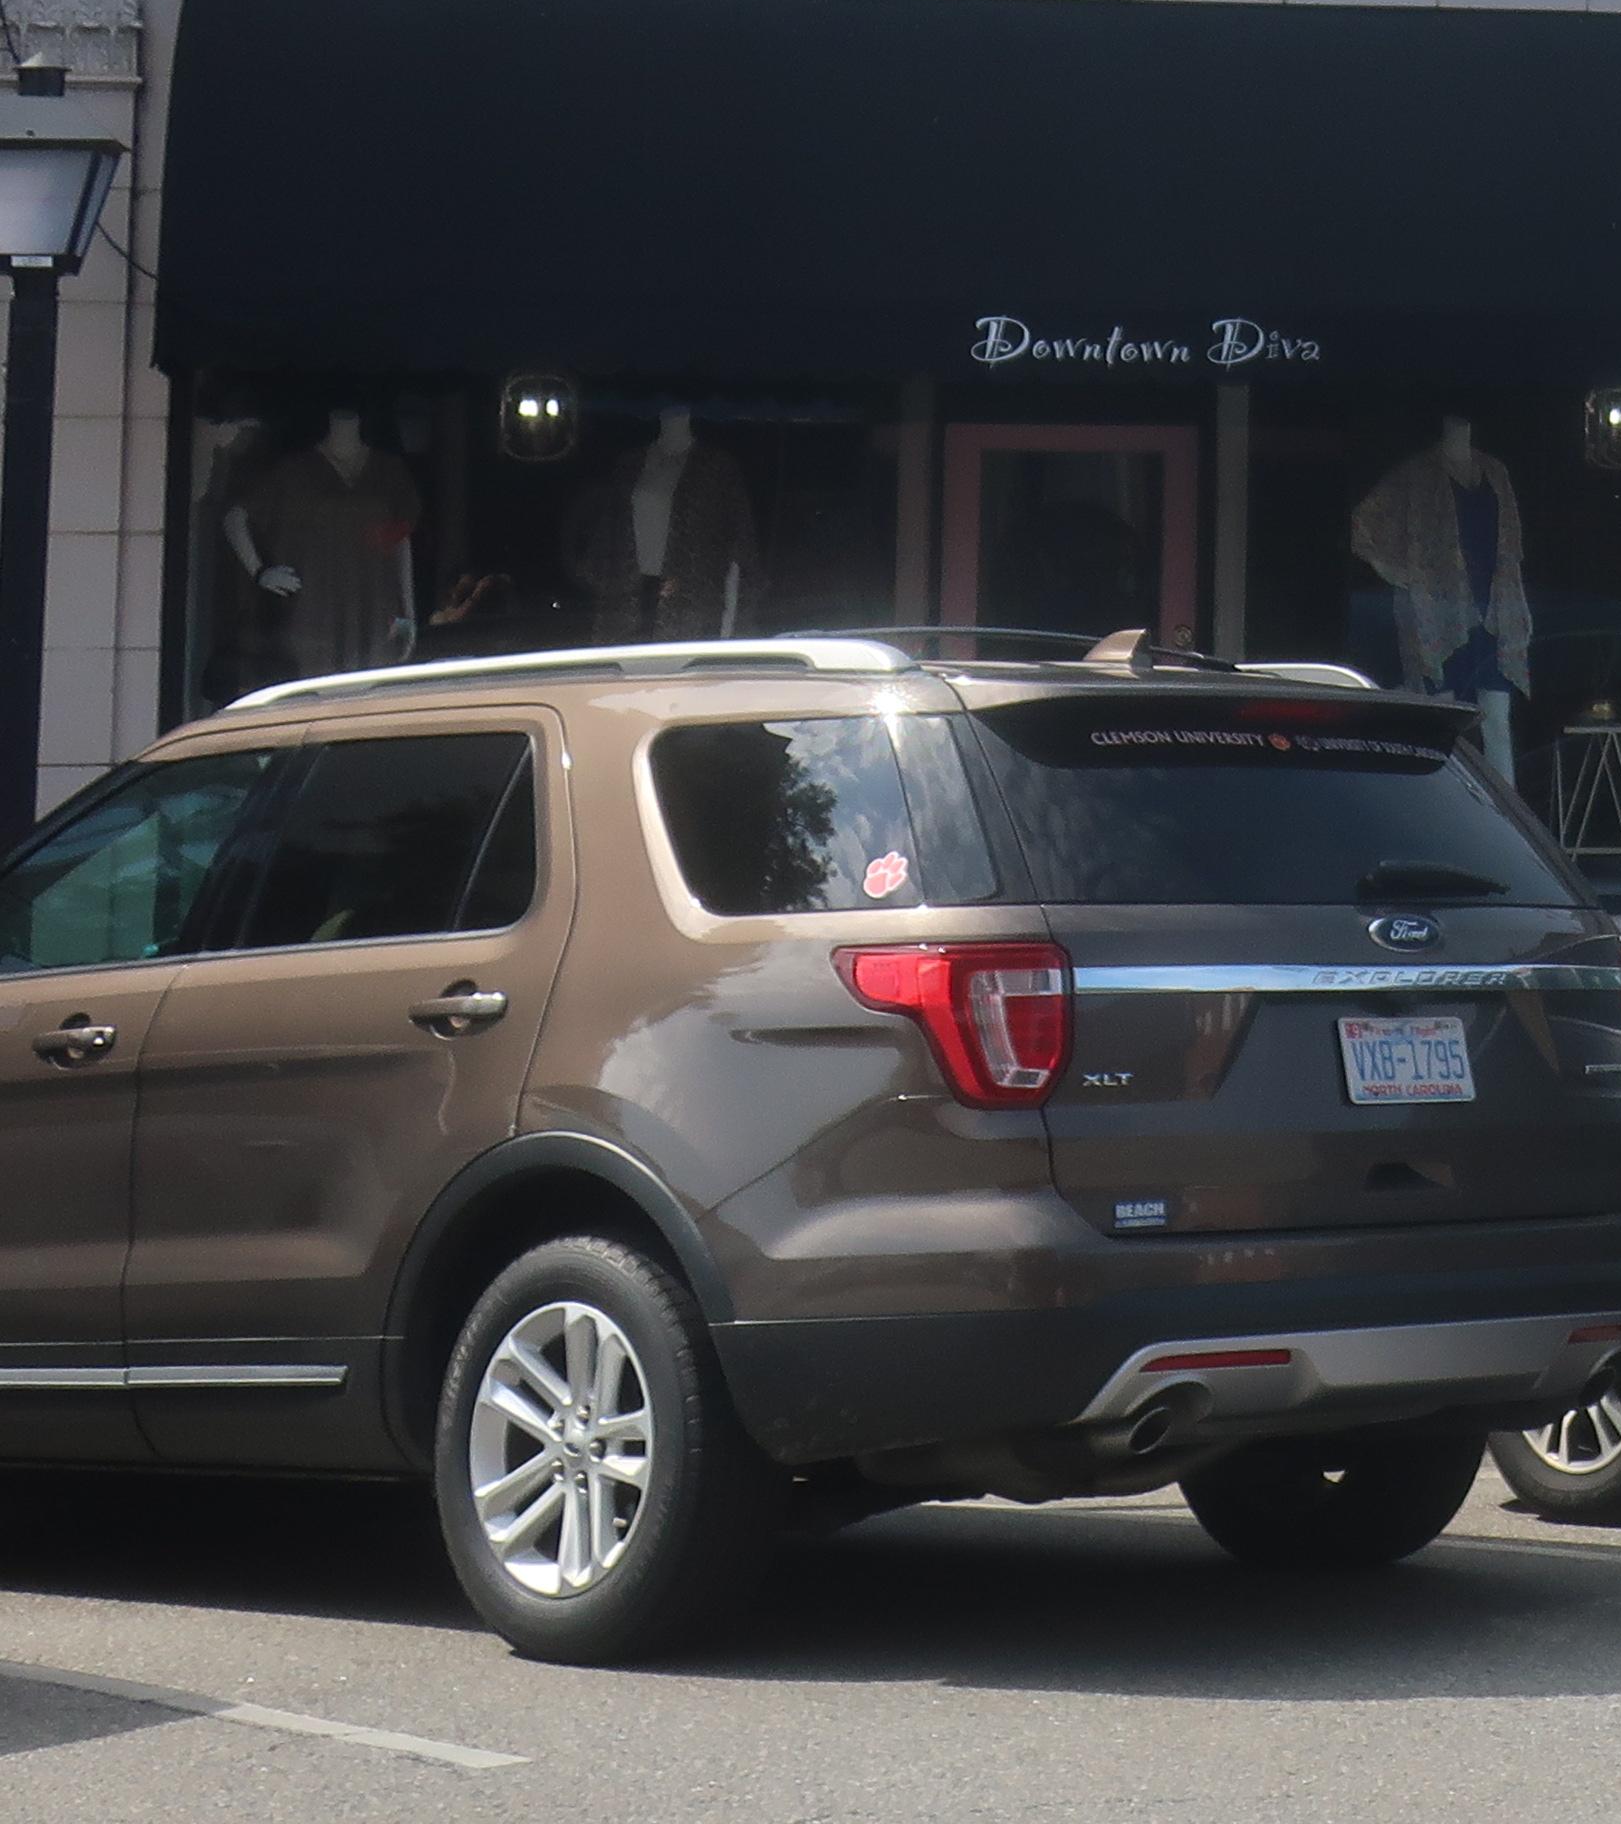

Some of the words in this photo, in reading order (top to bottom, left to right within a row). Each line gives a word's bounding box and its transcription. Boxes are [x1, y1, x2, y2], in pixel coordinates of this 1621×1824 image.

[970, 315, 1191, 370] Downtown
[1207, 317, 1320, 371] Diva
[1090, 730, 1172, 746] CLEMSON
[1174, 730, 1266, 748] UNIVERSITY
[1389, 918, 1429, 942] Ford
[1349, 1039, 1465, 1082] VXB-1795
[1082, 1072, 1135, 1087] XLT
[1114, 1202, 1166, 1218] BEACH
